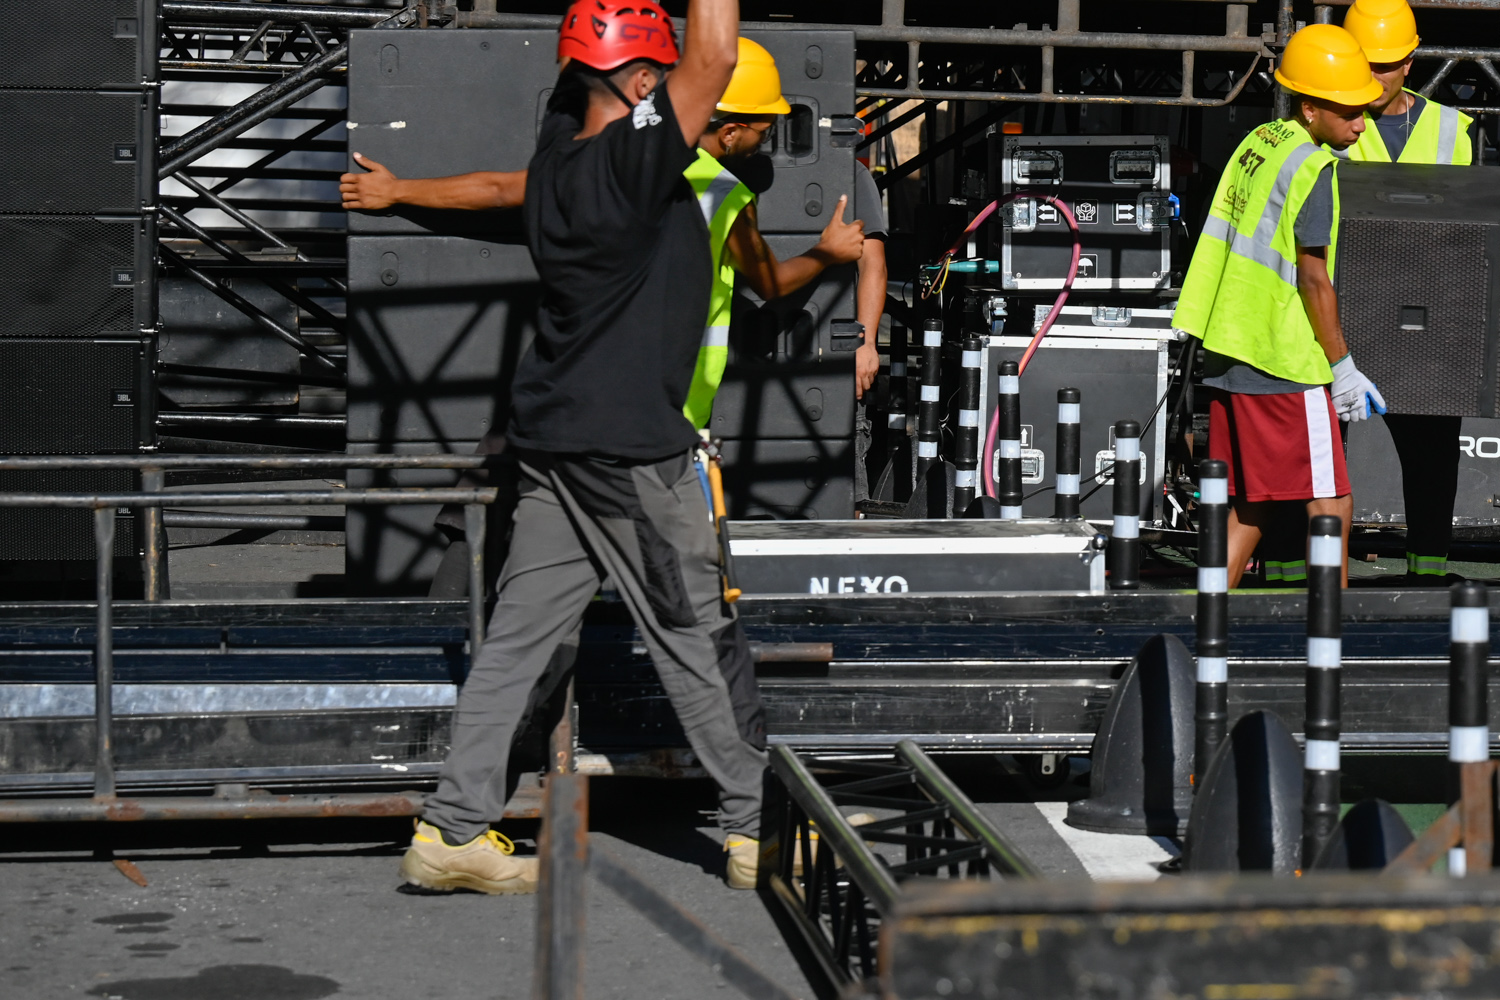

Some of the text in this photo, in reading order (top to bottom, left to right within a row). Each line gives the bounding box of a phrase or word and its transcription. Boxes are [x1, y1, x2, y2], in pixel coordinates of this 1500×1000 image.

[119, 149, 133, 157] JBL
[118, 273, 132, 282] JBL
[117, 394, 131, 402] JBL
